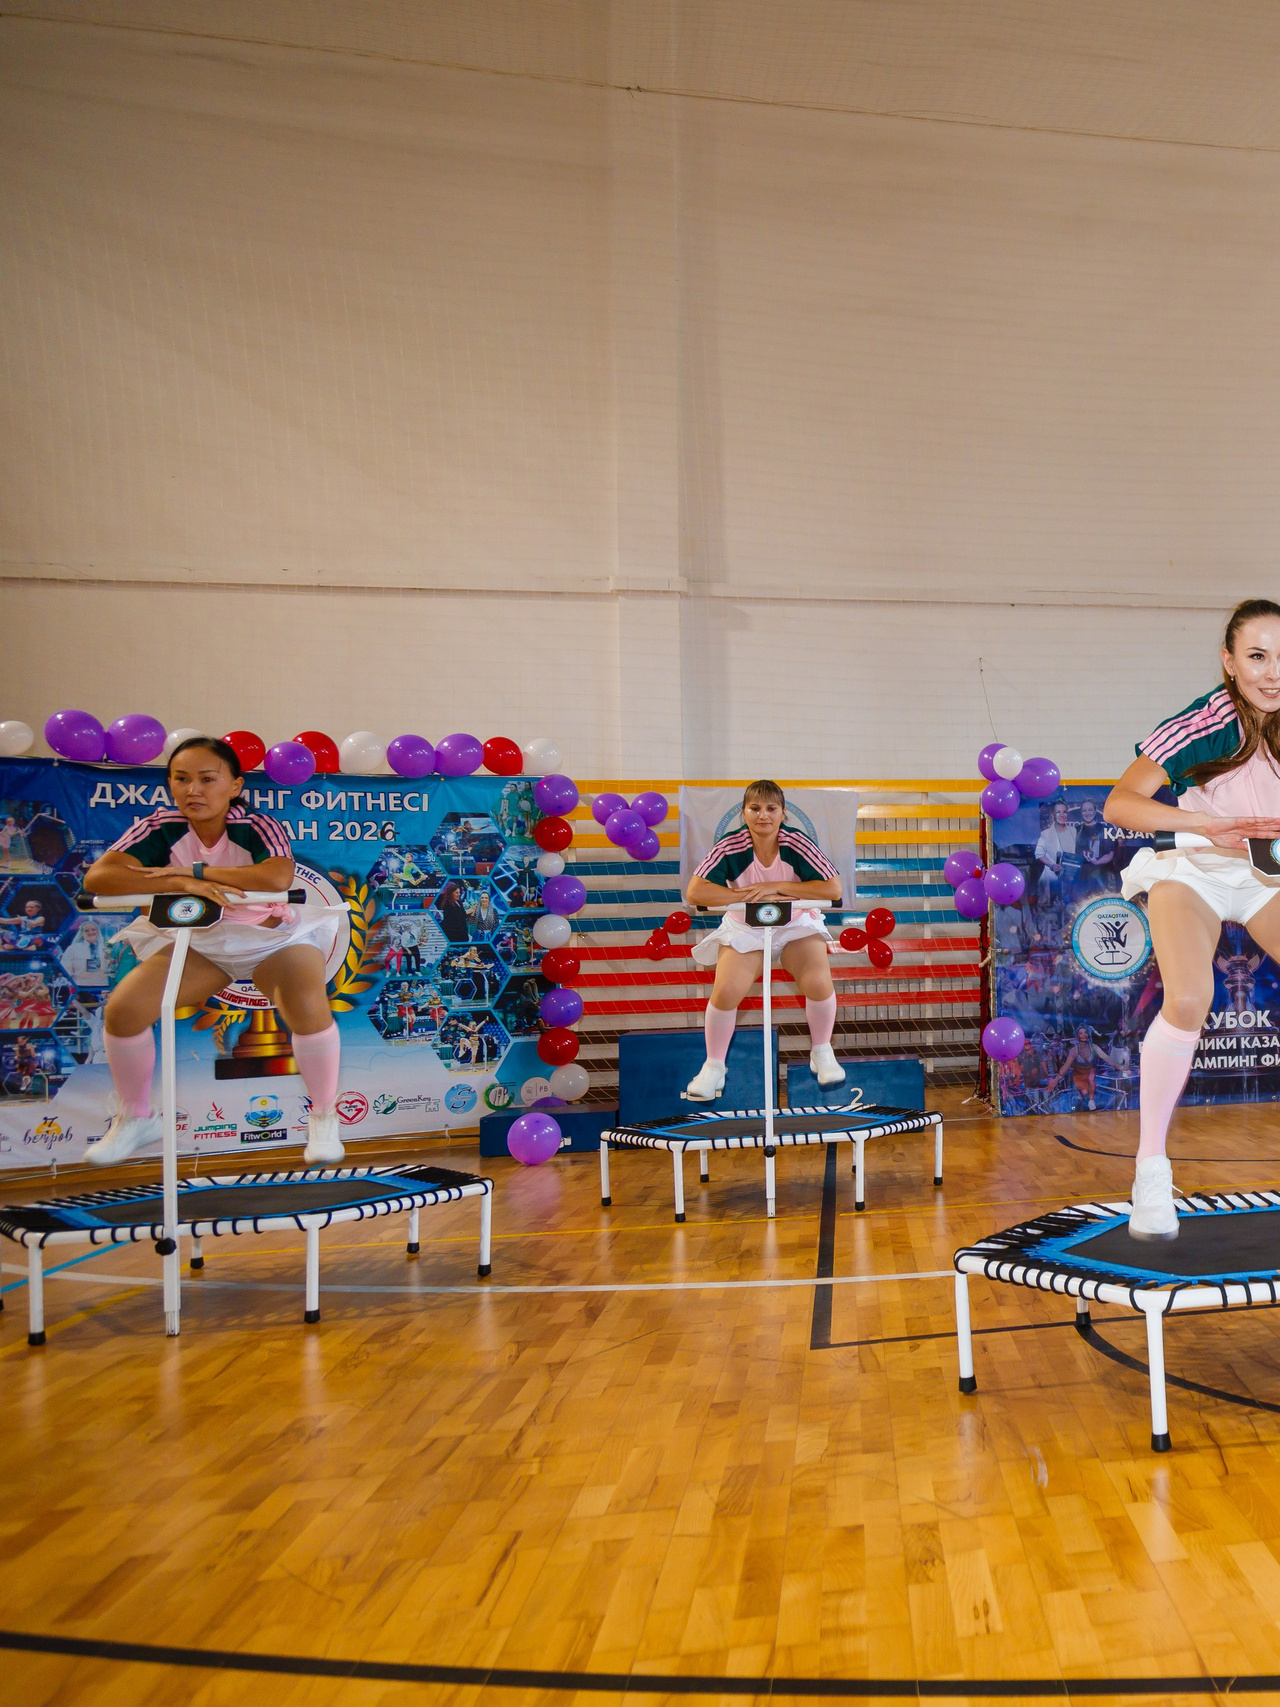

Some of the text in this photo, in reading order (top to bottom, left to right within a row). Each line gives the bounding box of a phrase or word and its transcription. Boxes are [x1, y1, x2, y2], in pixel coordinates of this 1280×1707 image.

[301, 790, 429, 812] ФИТНЕСІ
[328, 821, 398, 842] 2026
[295, 866, 321, 885] ТНЕС
[1190, 1055, 1257, 1069] АМПИНГ
[850, 1087, 863, 1106] 2
[194, 1131, 238, 1140] FITNESS
